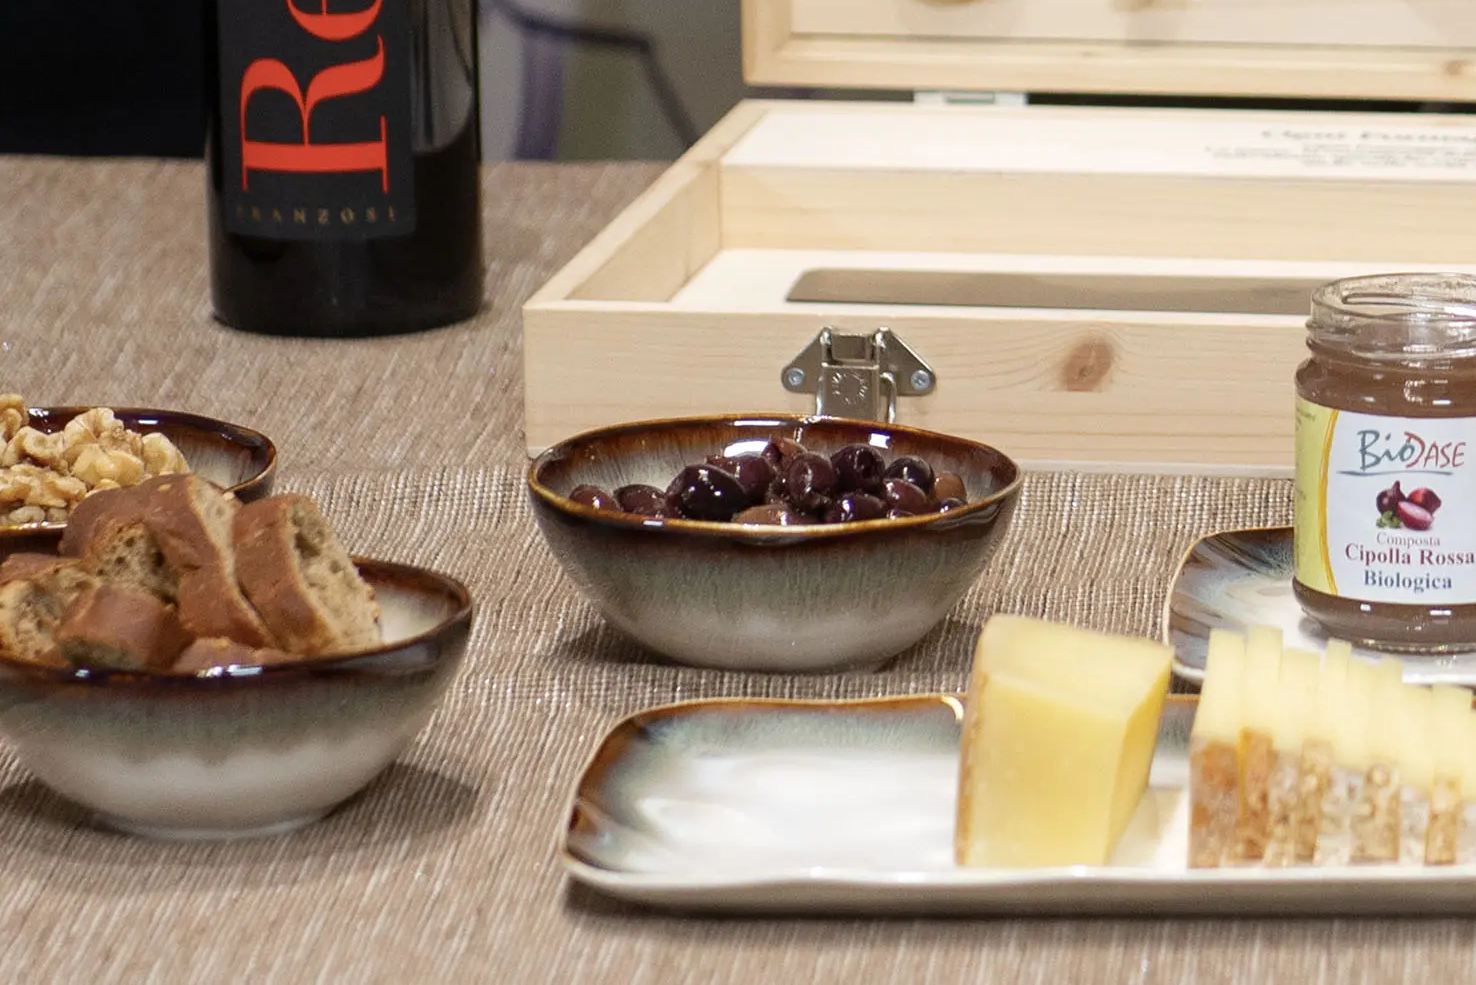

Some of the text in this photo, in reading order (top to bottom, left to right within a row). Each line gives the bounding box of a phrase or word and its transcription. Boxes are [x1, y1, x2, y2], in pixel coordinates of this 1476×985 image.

[1376, 532, 1441, 548] Composta
[1345, 543, 1476, 566] Cipolla Rossa
[1363, 569, 1453, 593] Biologica
